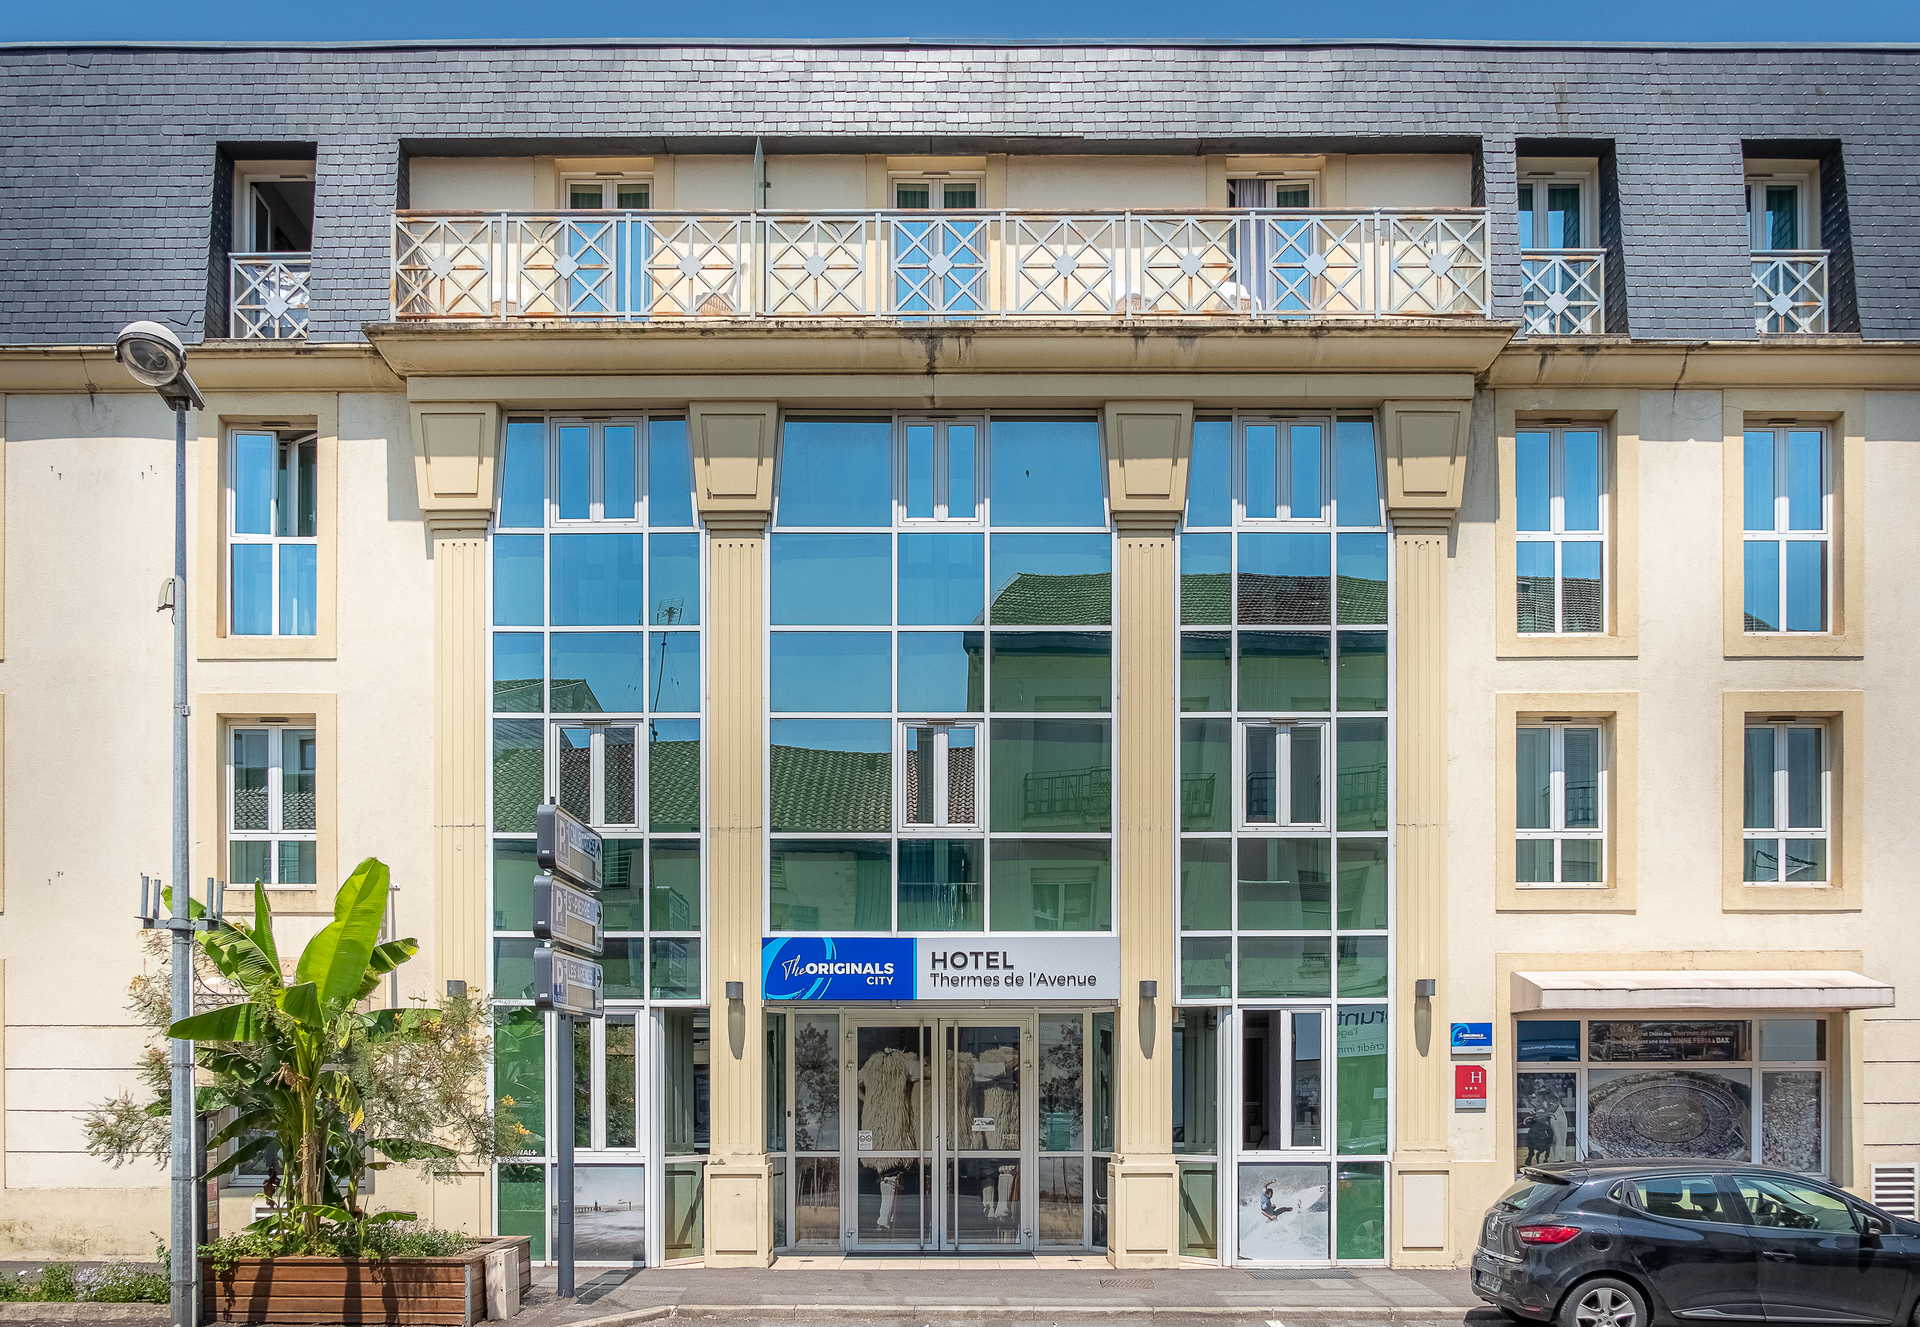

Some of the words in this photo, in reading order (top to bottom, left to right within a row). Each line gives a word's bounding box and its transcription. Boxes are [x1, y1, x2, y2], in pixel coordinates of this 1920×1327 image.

[782, 955, 807, 981] The
[806, 962, 895, 975] ORIGINALS
[931, 951, 1015, 970] HOTEL
[866, 976, 895, 986] CITY
[930, 972, 1000, 988] Thermes
[1004, 972, 1025, 988] de
[1029, 972, 1098, 988] l'Avenue
[1471, 1071, 1482, 1083] H
